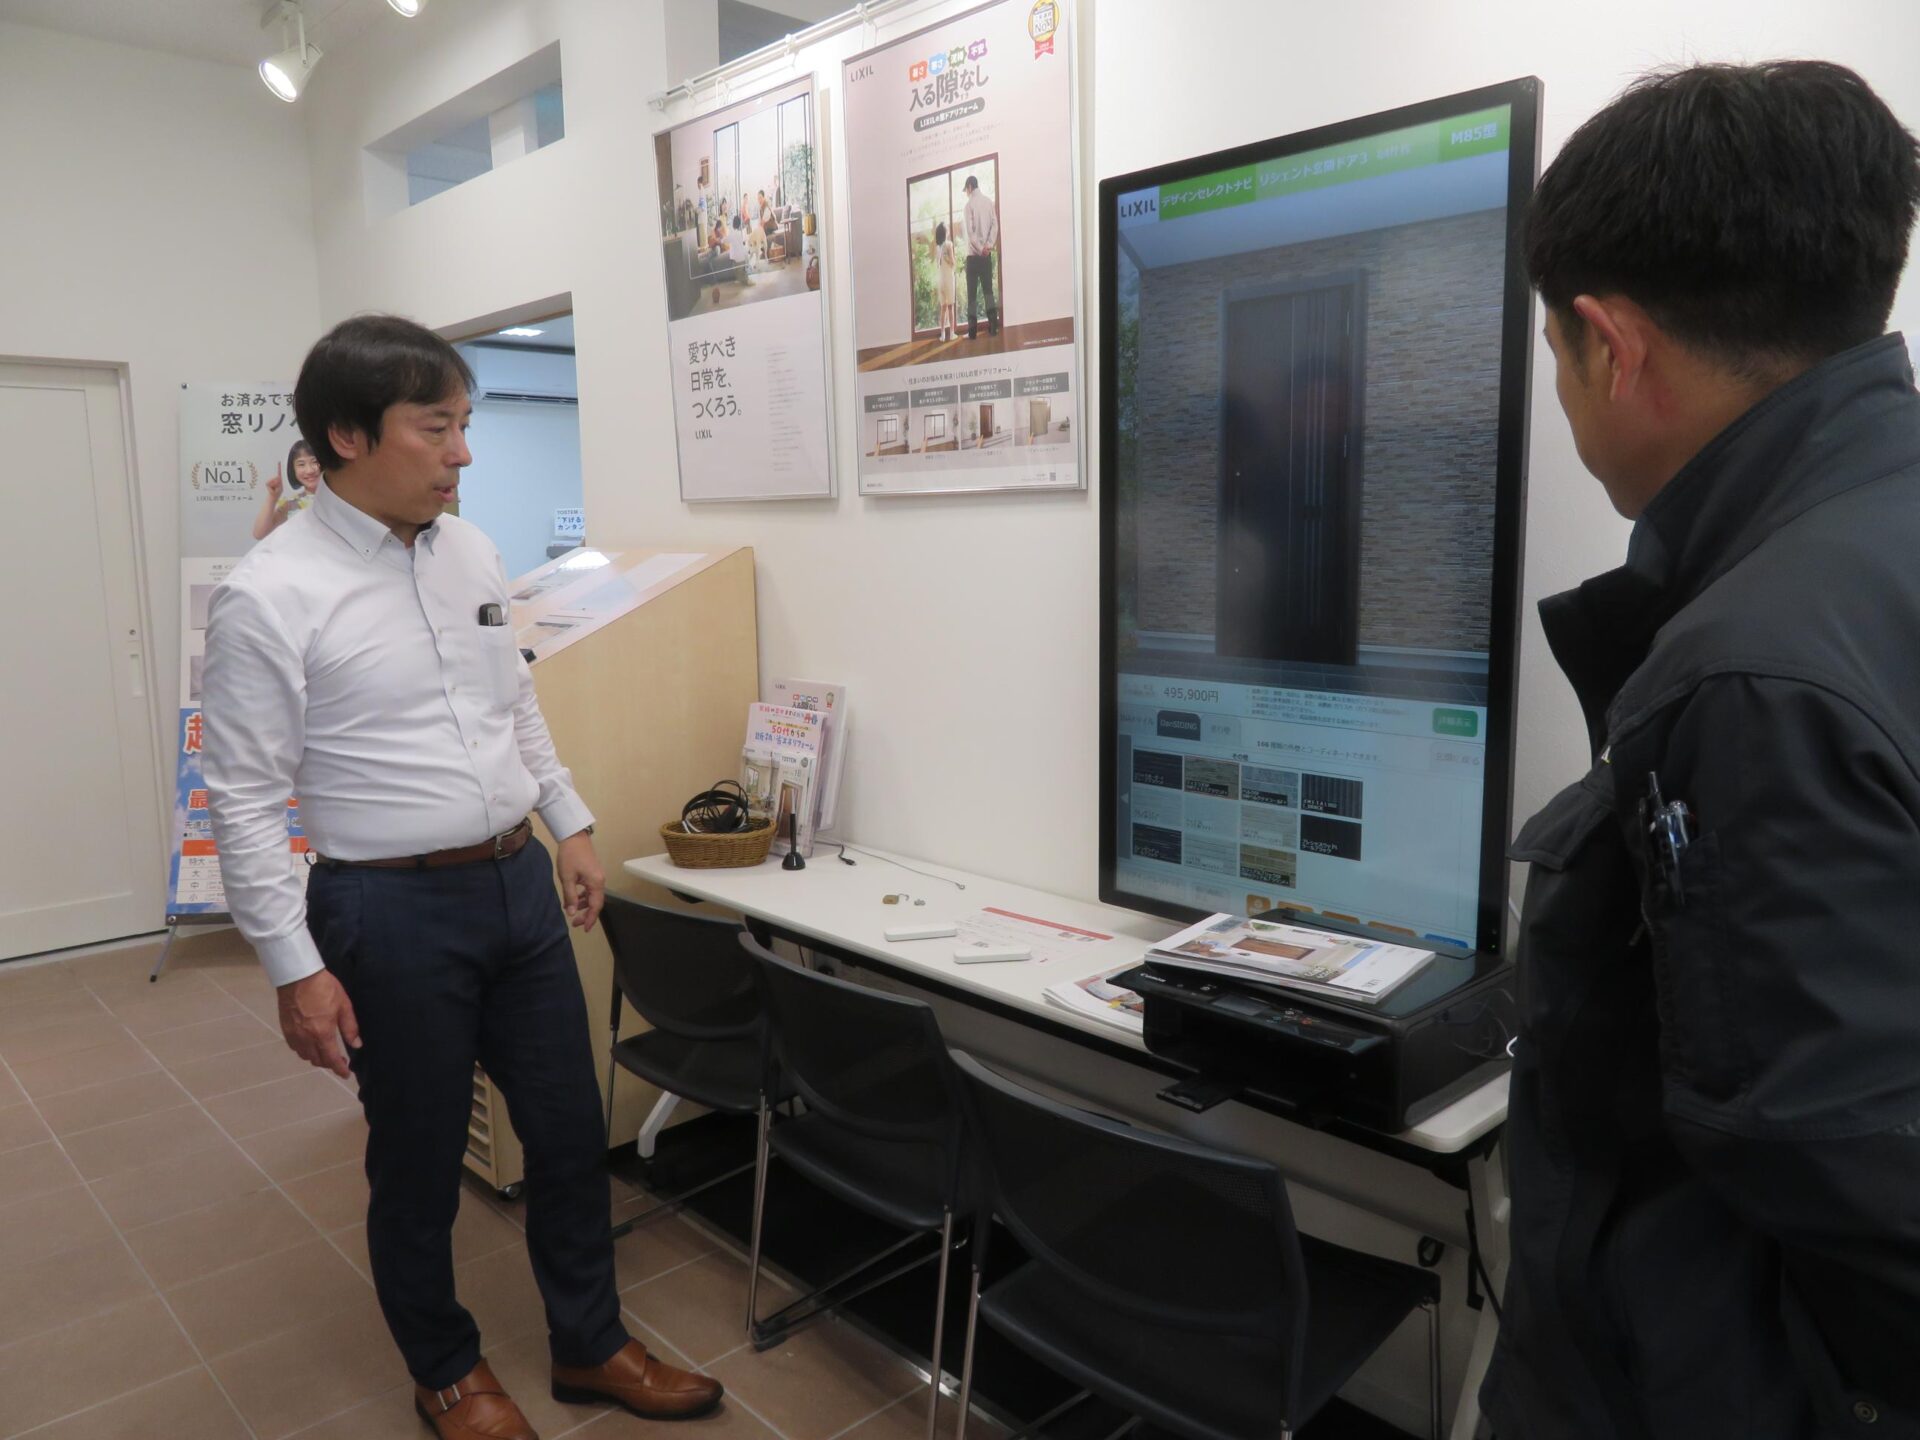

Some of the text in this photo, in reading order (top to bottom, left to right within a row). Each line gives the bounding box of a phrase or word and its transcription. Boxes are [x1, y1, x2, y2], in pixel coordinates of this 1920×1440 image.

[850, 67, 874, 82] LIXIL
[909, 65, 989, 112] 入る隙なし
[1452, 122, 1497, 145] M85型
[1259, 151, 1368, 187] リシェント玄関ドア3
[1161, 178, 1252, 207] デザインセレクトナビ
[1120, 199, 1156, 218] LIXIL
[688, 335, 736, 365] 愛すべき
[690, 367, 732, 393] 日常を、
[692, 395, 742, 419] つくろう。
[695, 429, 712, 440] LIXIL
[205, 467, 246, 484] No.1
[1163, 687, 1219, 703] 495,900円
[190, 881, 200, 889] 中
